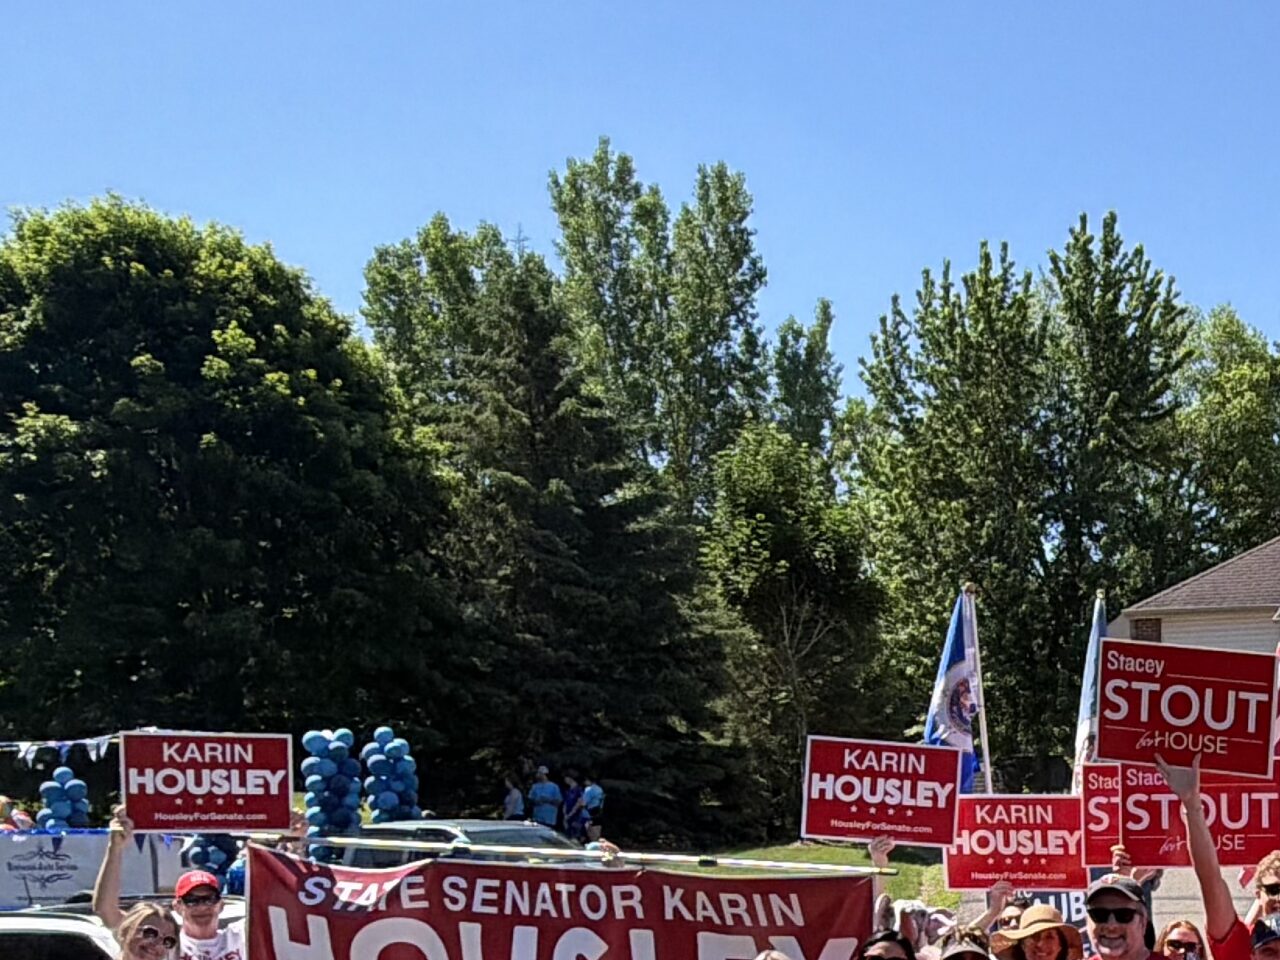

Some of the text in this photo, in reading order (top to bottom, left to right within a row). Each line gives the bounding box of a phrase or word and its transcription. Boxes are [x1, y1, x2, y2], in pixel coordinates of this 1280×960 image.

[1107, 650, 1165, 678] Stacey
[1103, 679, 1269, 733] STOUT
[162, 742, 253, 763] KARIN
[1154, 732, 1229, 754] HOUSE
[844, 749, 926, 775] KARIN
[128, 768, 287, 795] HOUSLEY
[1088, 772, 1120, 790] Stac
[1126, 768, 1168, 787] Stac
[811, 772, 955, 809] HOUSLEY
[154, 811, 267, 822] HousleyForSenate.com
[975, 804, 1053, 825] KARIN
[830, 818, 933, 834] HousleyForSenate.com
[951, 829, 1082, 856] HOUSLEY
[971, 871, 1067, 881] HousleyForSenate.com
[298, 875, 806, 927] STATE SENATOR KARIN
